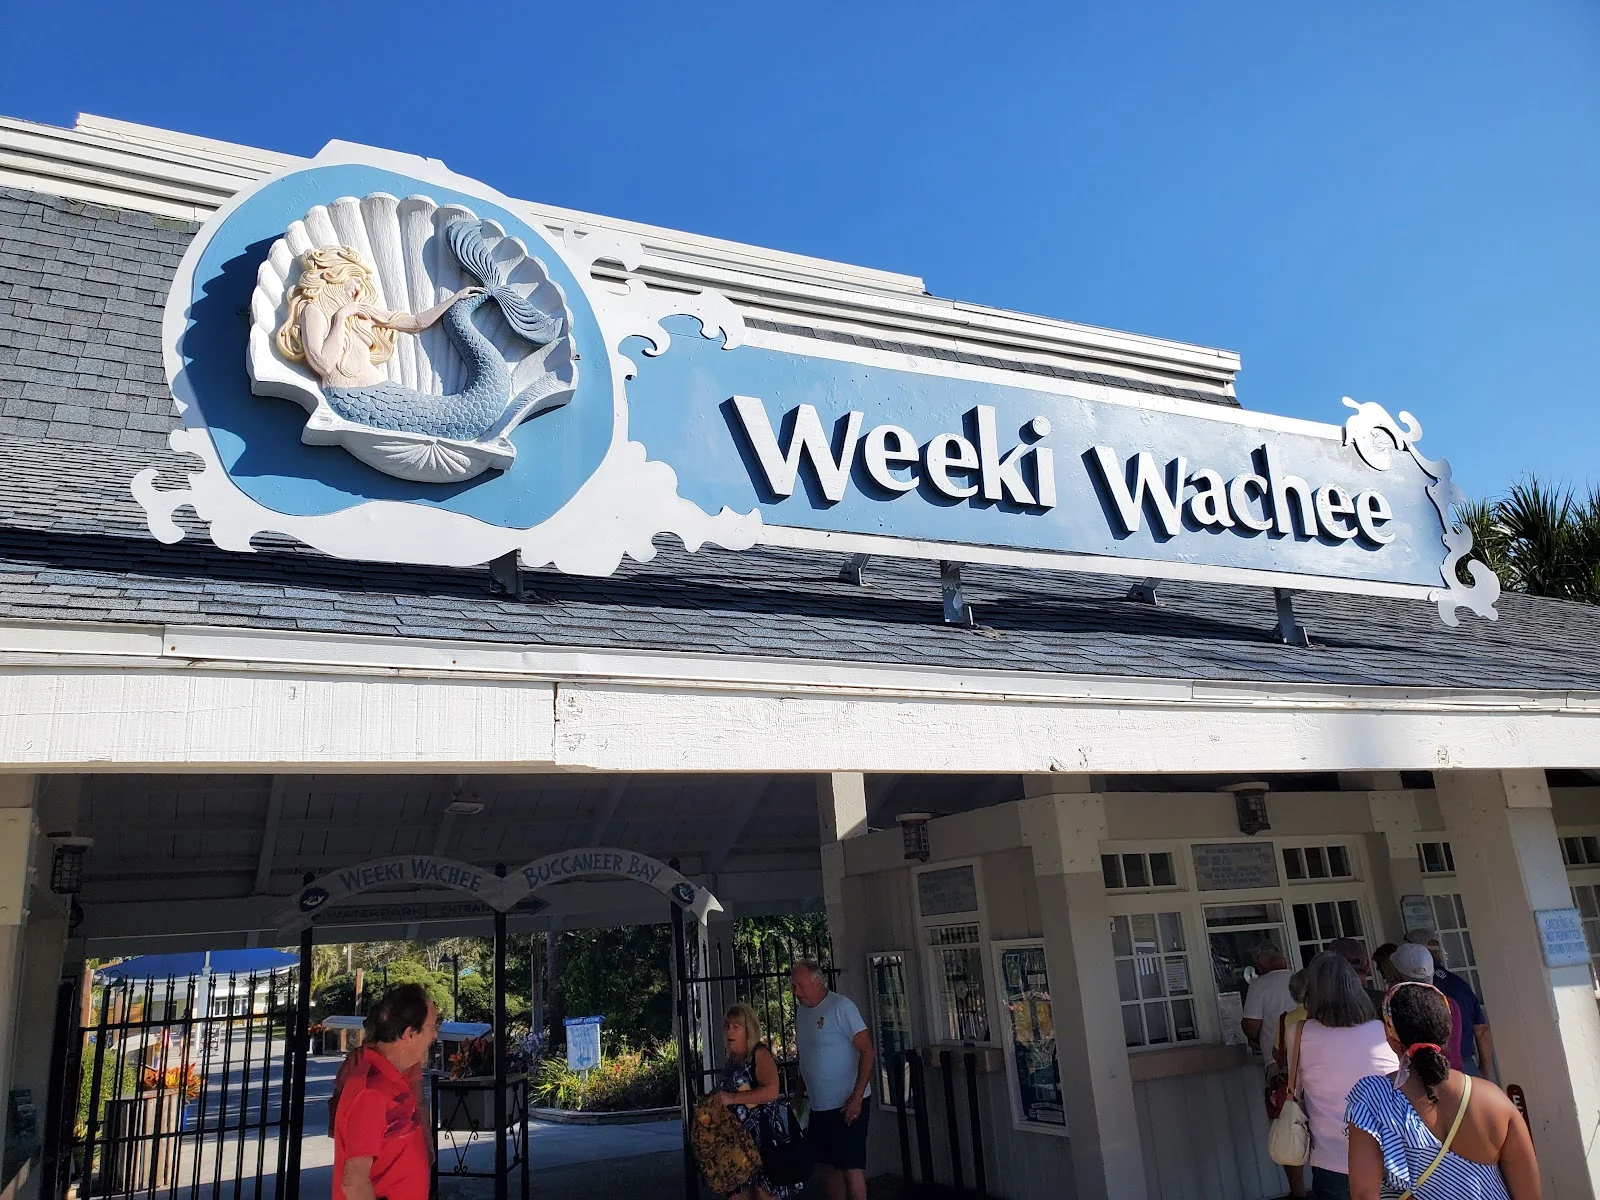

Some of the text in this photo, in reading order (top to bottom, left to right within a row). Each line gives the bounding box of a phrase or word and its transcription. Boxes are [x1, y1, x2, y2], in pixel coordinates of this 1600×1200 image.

[727, 394, 1396, 546] Weeki Wachee
[339, 859, 484, 892] WEEKI WACHEE
[522, 853, 663, 890] BUCCANEER BAY
[326, 906, 423, 920] WATERPARK
[1545, 918, 1569, 929] SMOKING
